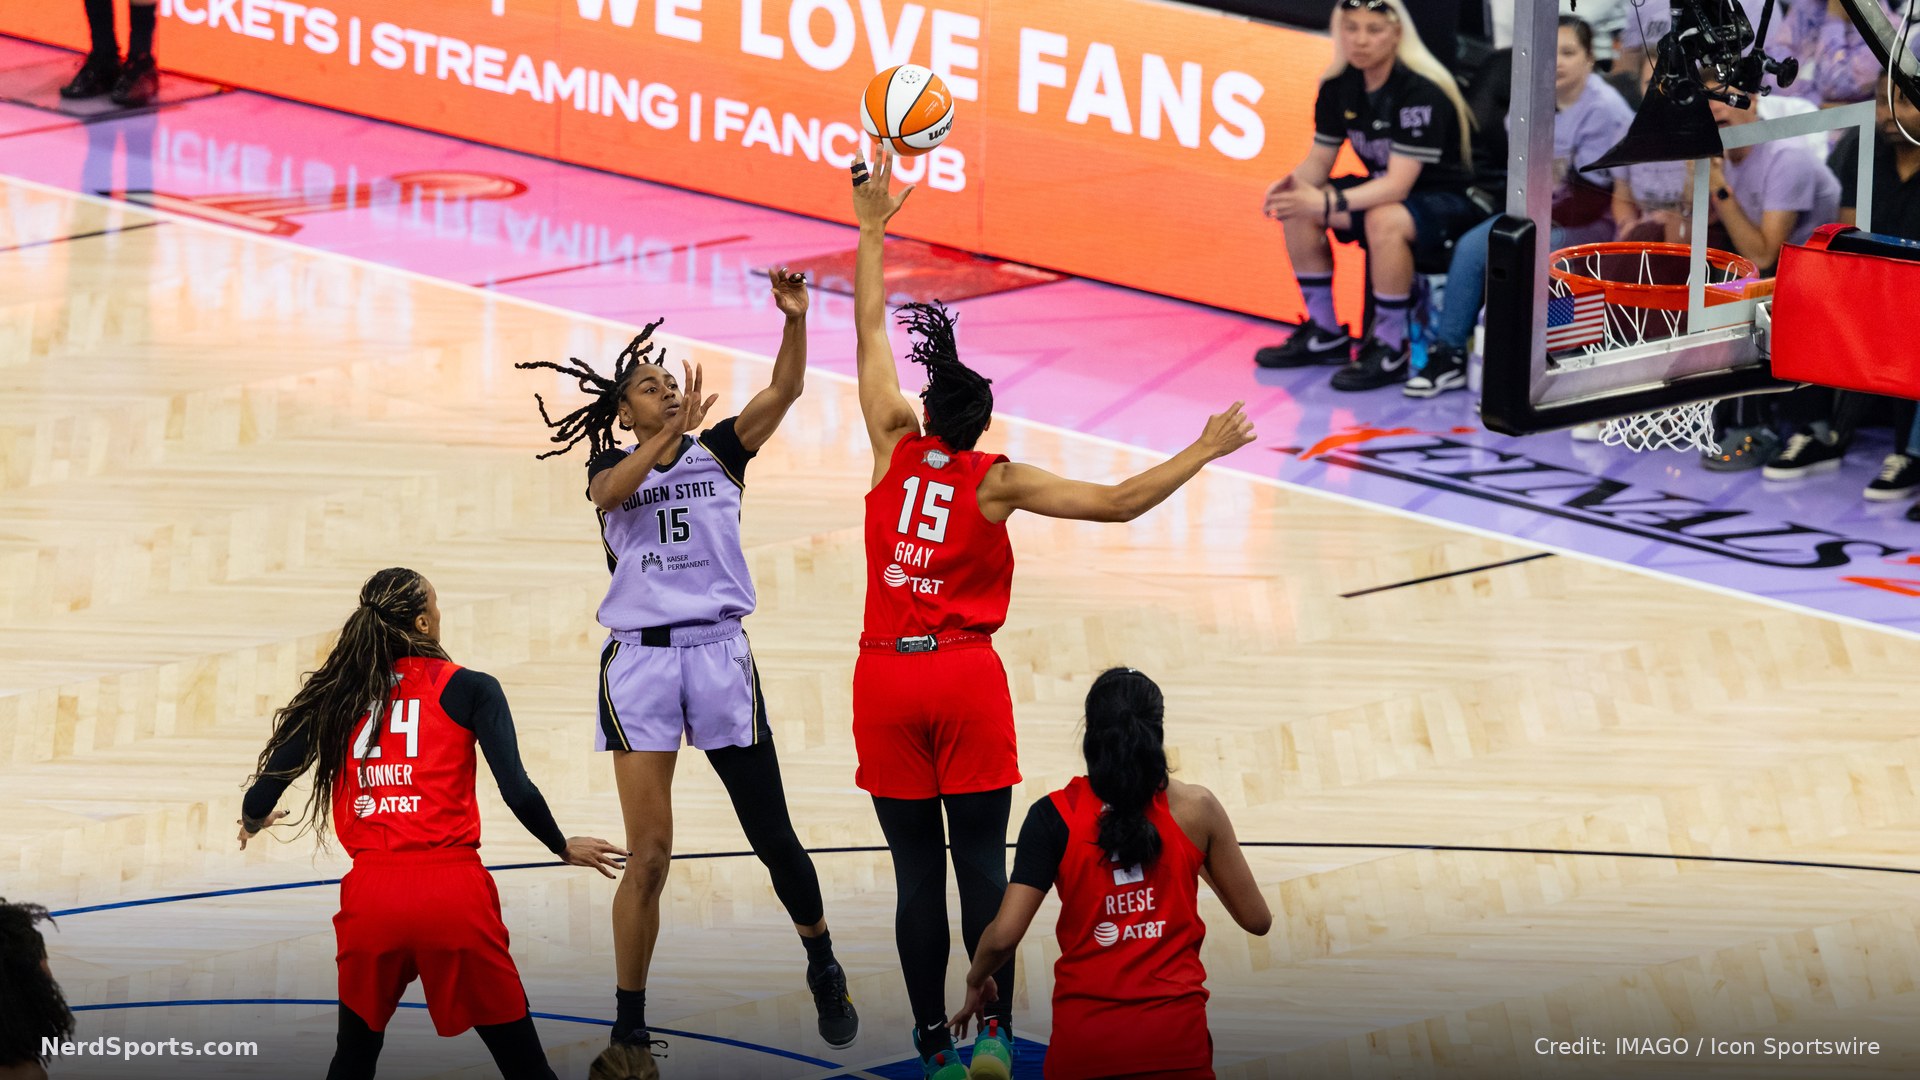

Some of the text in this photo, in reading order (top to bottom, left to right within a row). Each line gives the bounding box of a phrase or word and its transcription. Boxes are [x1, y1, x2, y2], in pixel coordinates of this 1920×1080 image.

[370, 22, 679, 130] STREAMING
[741, 0, 980, 102] LOVE
[1018, 27, 1266, 160] FANS
[675, 481, 716, 500] STATE
[896, 475, 956, 544] 15
[656, 506, 691, 545] 15
[666, 554, 689, 563] KAISER
[667, 559, 710, 571] PERMANENTE
[894, 541, 935, 569] GRAY
[905, 575, 944, 595] T&T
[351, 698, 421, 759] 24
[377, 795, 422, 814] AT&T
[1105, 887, 1156, 916] REESE
[1122, 920, 1167, 941] AT&T
